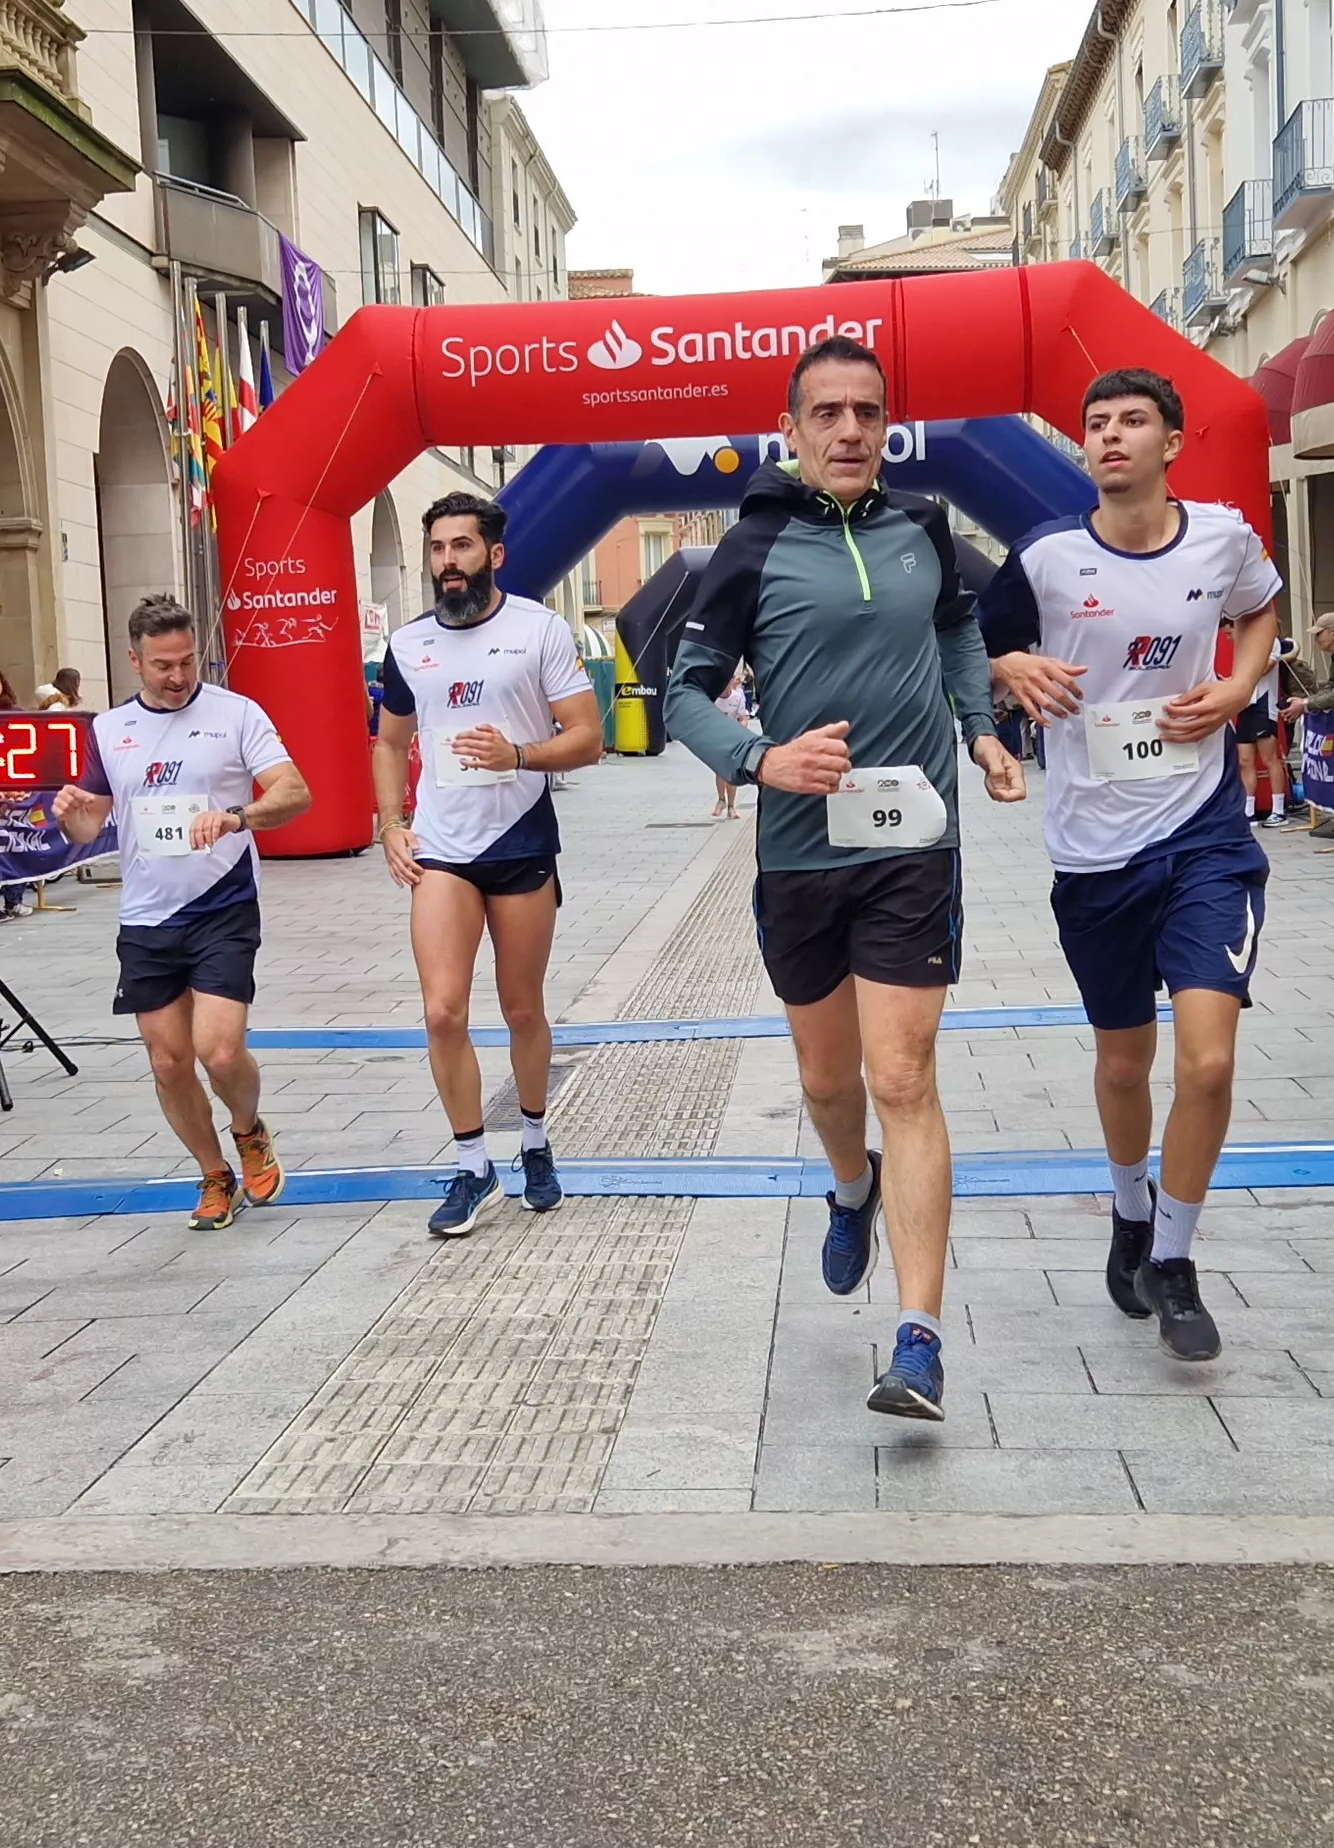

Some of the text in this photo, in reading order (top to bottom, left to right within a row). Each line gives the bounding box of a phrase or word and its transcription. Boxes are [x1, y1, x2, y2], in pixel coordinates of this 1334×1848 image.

[441, 336, 578, 387] Sports
[582, 383, 729, 408] sportssantander.es
[245, 557, 305, 580] Sports
[243, 587, 337, 609] Santander
[1070, 608, 1115, 619] Santander
[621, 685, 657, 696] embou
[1122, 739, 1163, 760] 100
[872, 808, 903, 828] 99
[155, 826, 183, 841] 481
